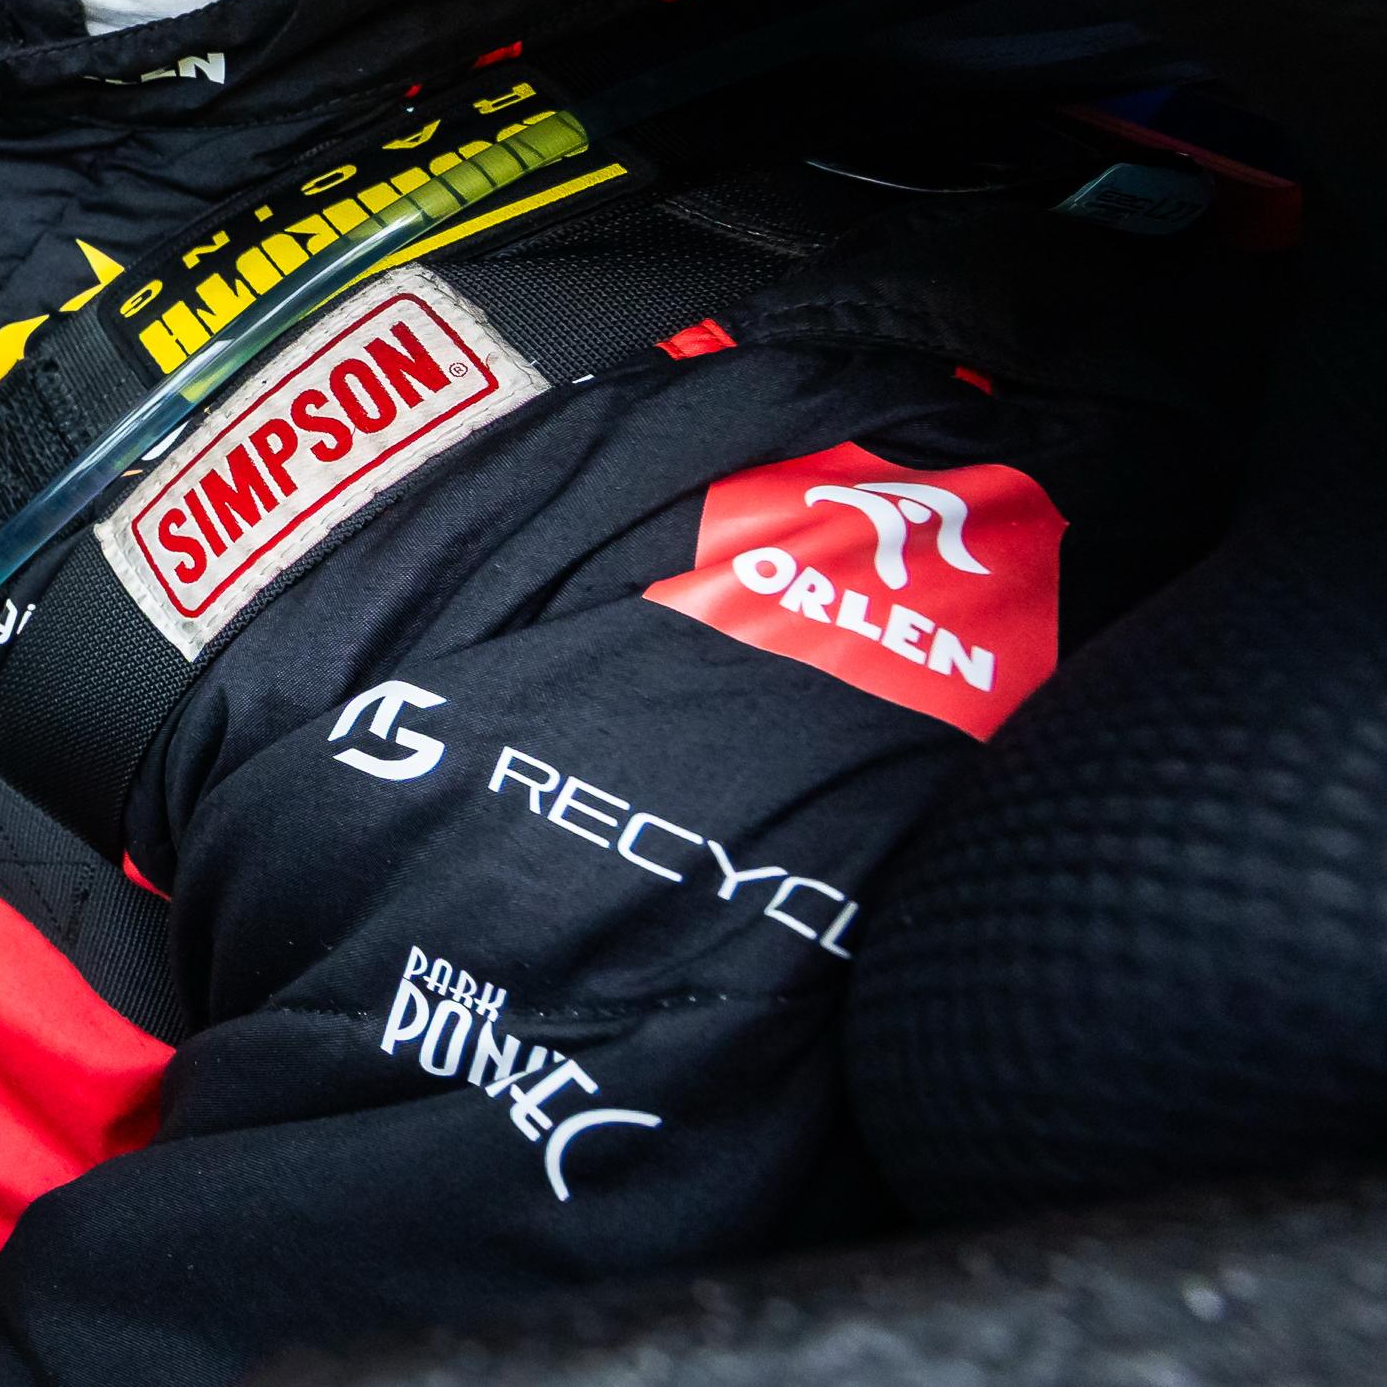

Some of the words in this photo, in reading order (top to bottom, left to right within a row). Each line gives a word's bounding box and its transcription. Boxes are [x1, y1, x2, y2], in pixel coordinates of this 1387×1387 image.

[119, 82, 537, 319] RACING
[156, 320, 449, 584] SIMPSON
[731, 544, 997, 693] ORLEN
[401, 944, 509, 1025] PARK
